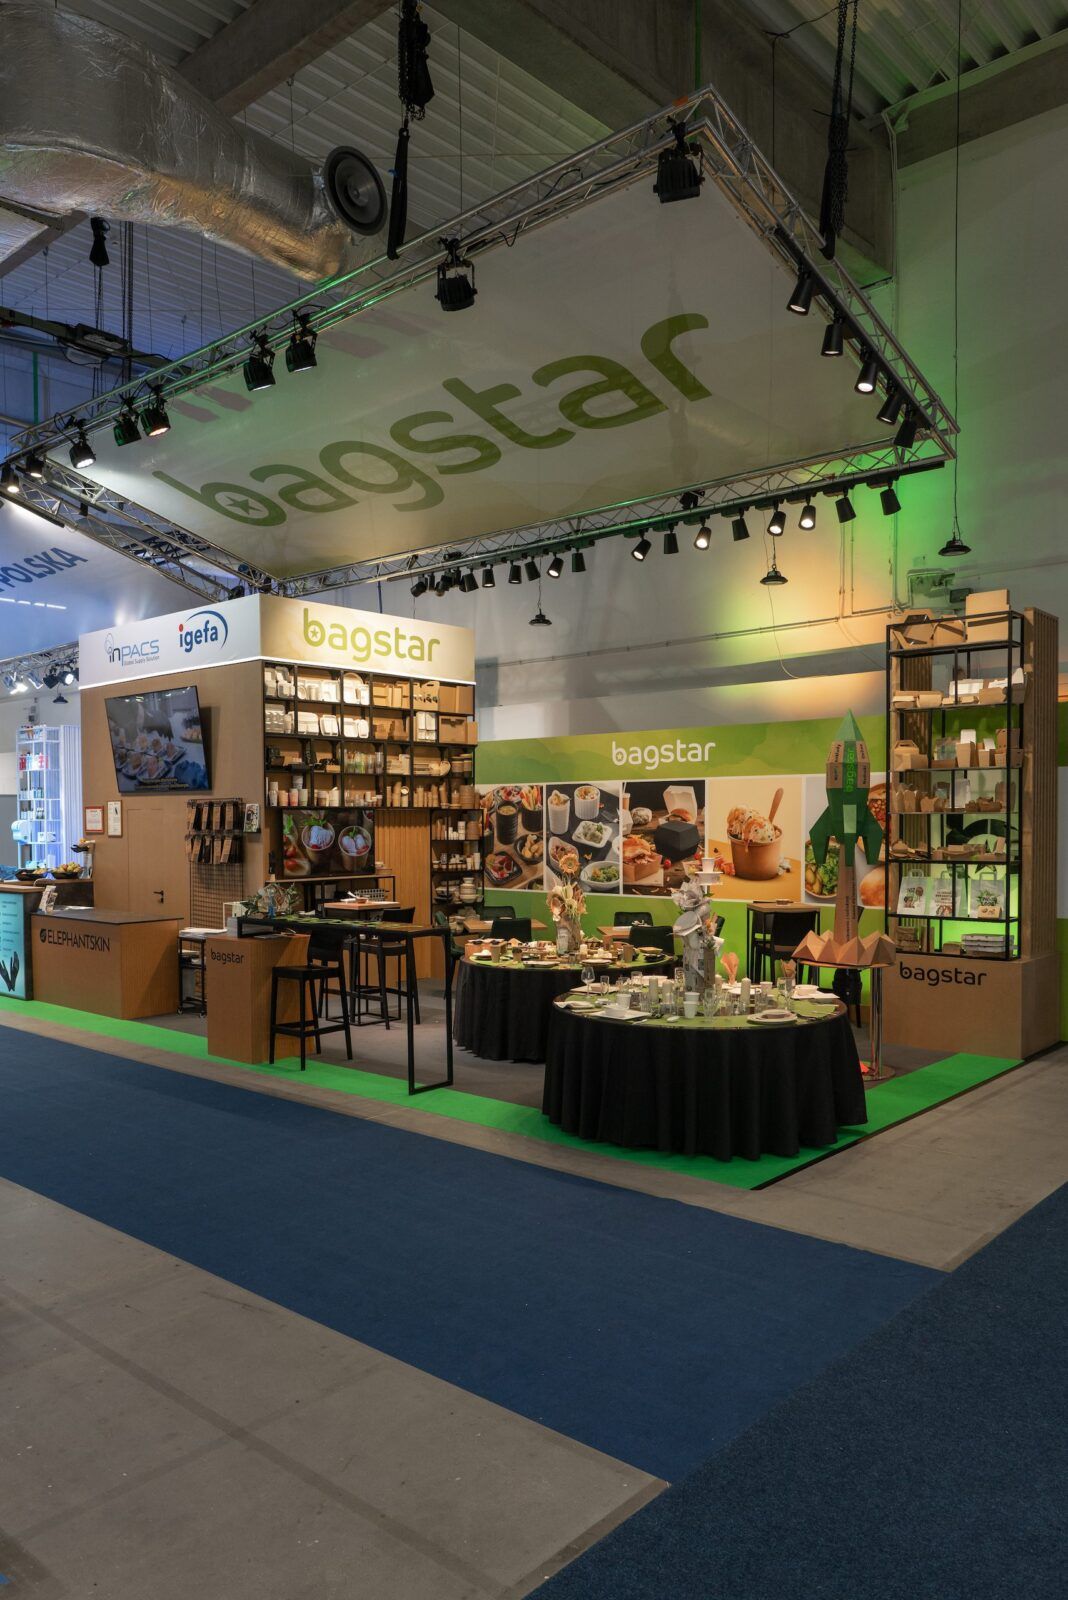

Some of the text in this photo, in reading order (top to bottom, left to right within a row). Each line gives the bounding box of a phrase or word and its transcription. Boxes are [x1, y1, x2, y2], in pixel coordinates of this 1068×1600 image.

[152, 312, 713, 527] bagstar
[178, 620, 219, 652] igefa
[303, 607, 441, 662] bagstar
[611, 738, 716, 771] bagstar
[47, 930, 110, 952] ELEPHANTSKIN
[210, 947, 245, 965] bagstar
[899, 961, 988, 987] bagstar
